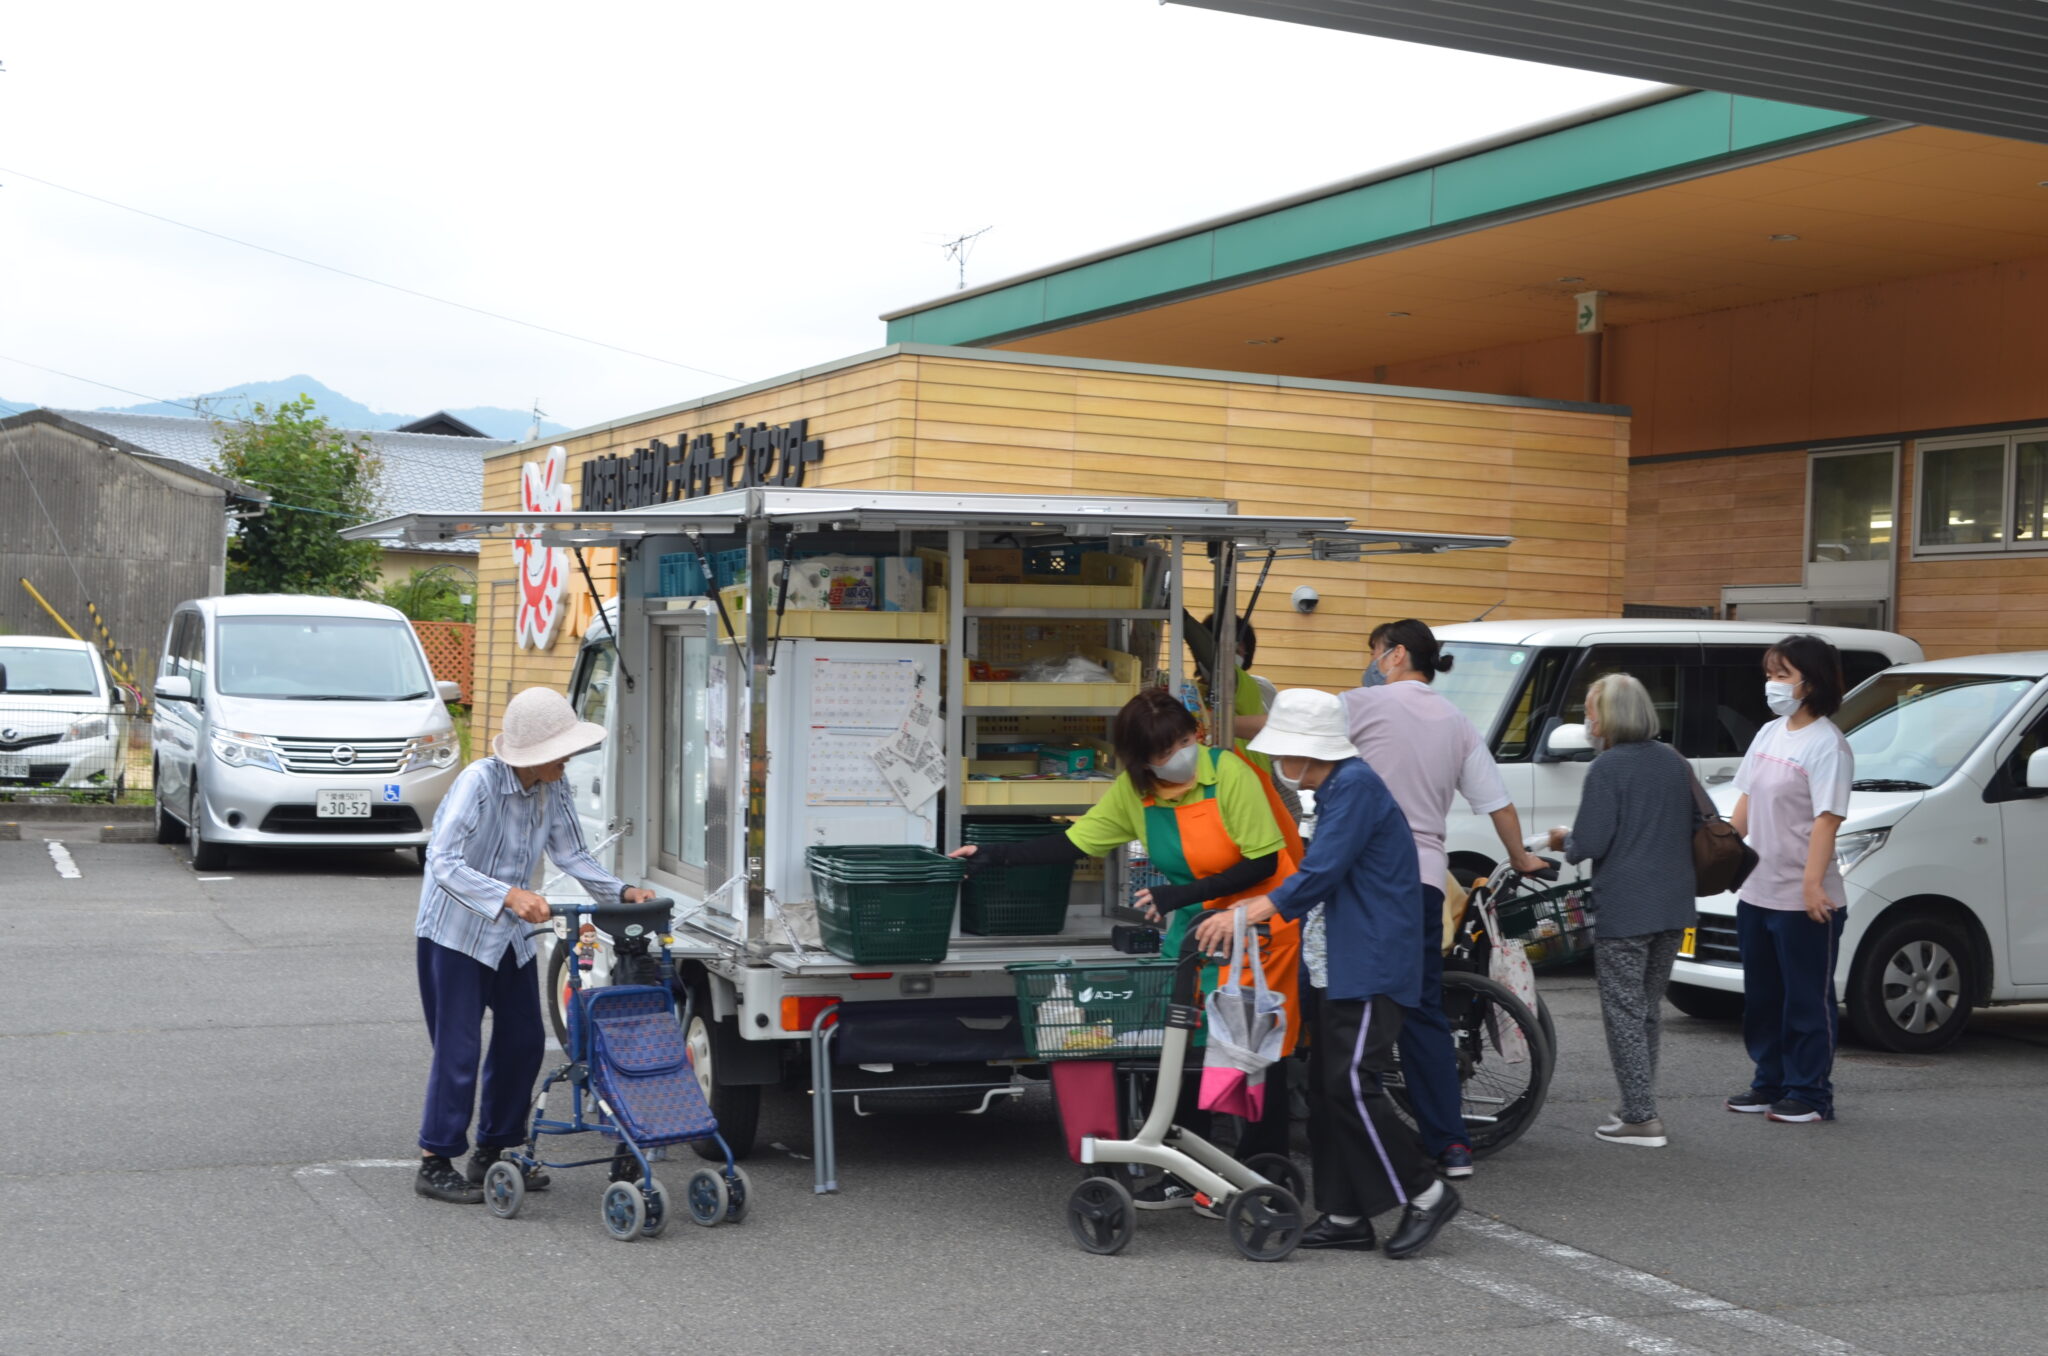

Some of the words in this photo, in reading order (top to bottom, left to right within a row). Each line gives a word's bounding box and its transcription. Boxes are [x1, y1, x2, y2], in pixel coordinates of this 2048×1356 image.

[329, 801, 368, 815] 30-52
[1094, 990, 1134, 1000] Aコープ
